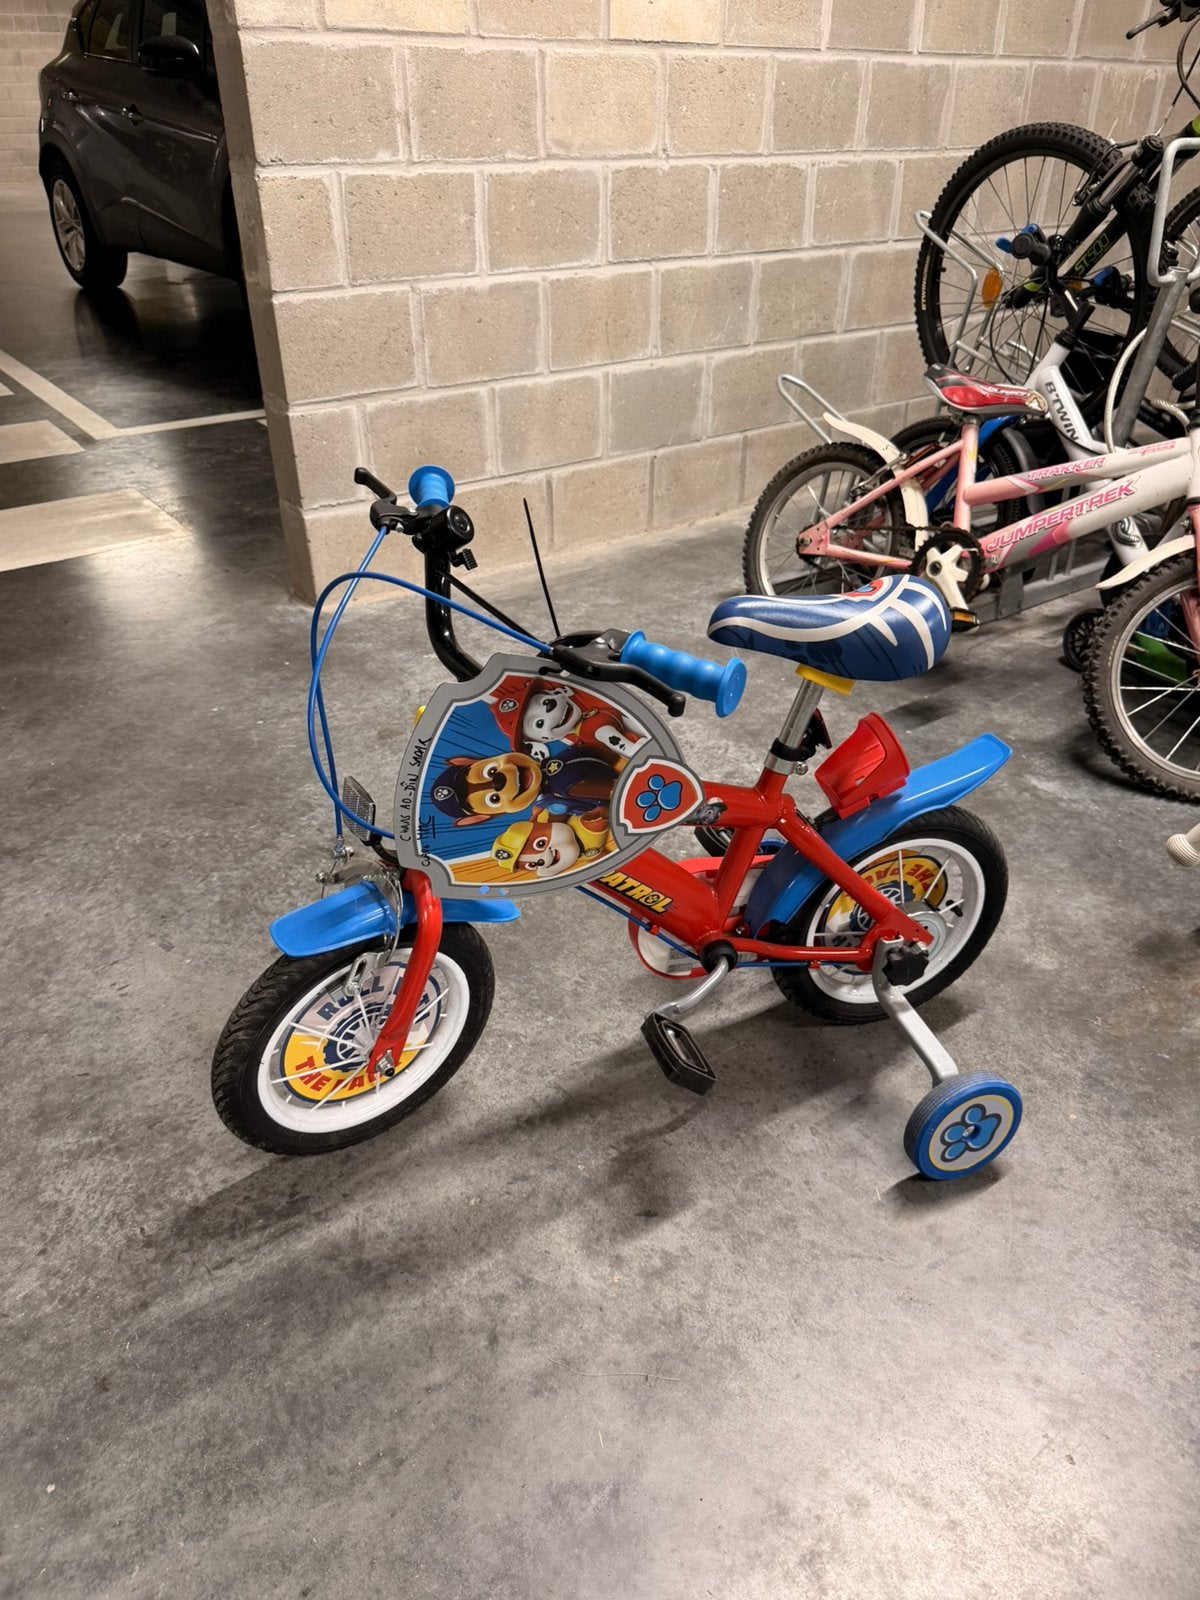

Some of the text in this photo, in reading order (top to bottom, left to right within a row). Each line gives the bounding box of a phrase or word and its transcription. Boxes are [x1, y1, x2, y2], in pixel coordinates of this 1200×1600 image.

[1075, 232, 1110, 275] ST500
[1029, 457, 1106, 481] TRAKKER
[987, 481, 1137, 552] JUMPERTREK
[600, 870, 673, 913] ATROL
[295, 1055, 331, 1092] THE
